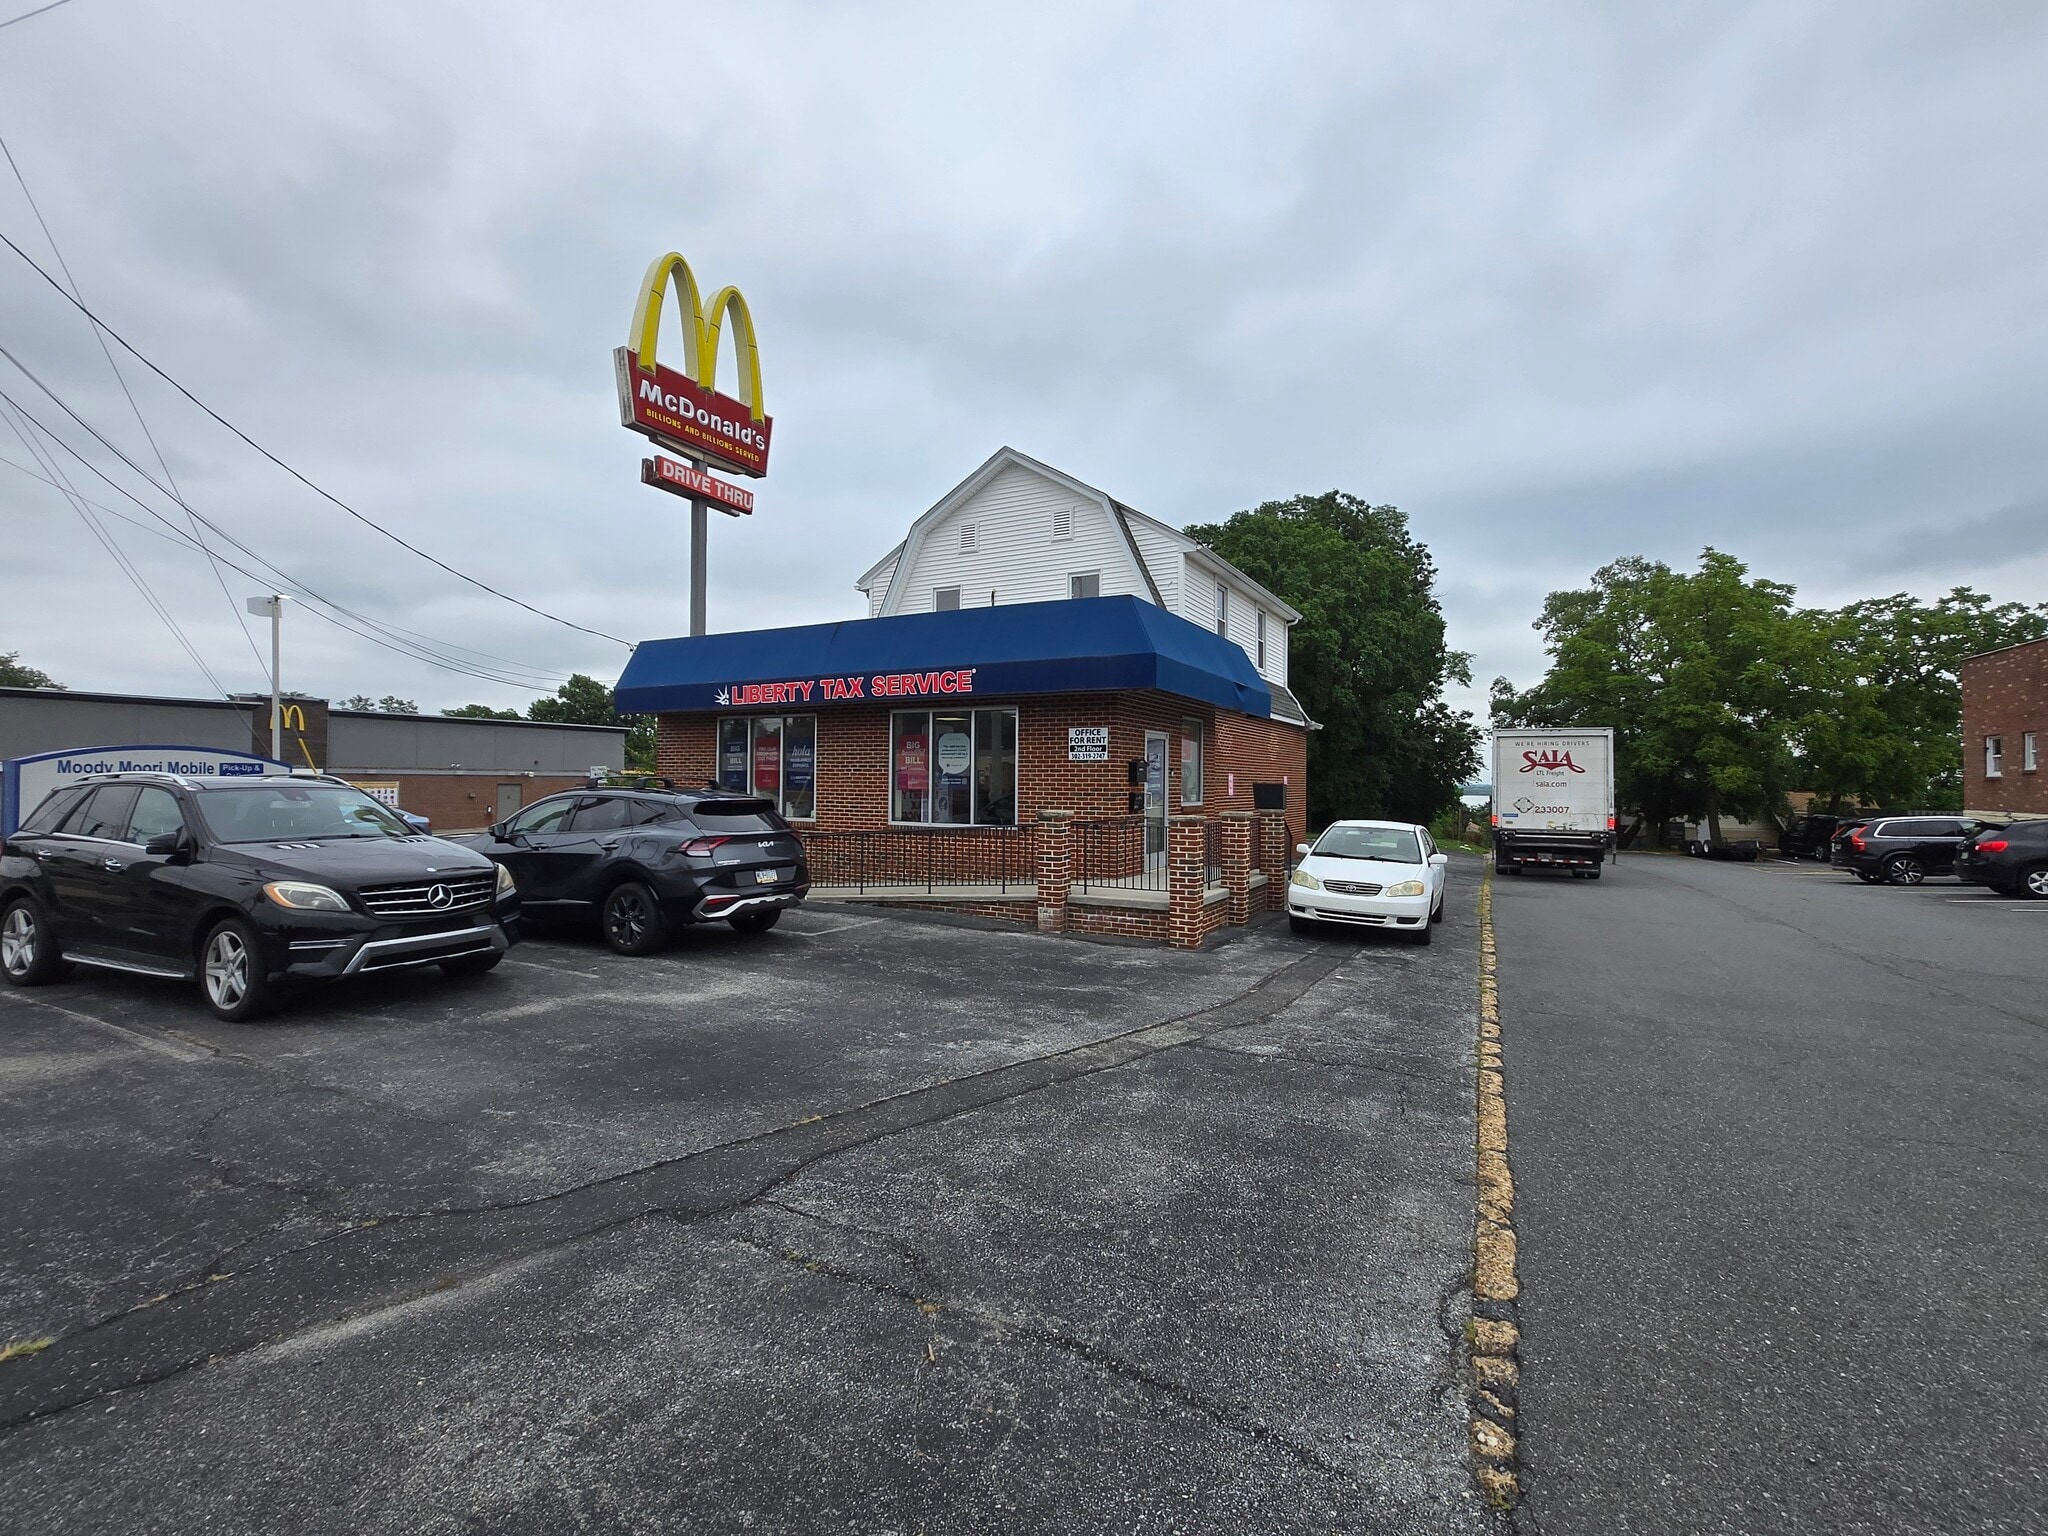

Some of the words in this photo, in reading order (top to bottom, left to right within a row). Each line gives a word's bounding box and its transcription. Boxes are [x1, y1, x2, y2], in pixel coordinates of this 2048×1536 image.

[639, 379, 766, 451] McDonald's
[646, 408, 682, 430] BILLIONS
[684, 424, 700, 437] AND
[702, 432, 733, 452] BILLIONS
[735, 446, 760, 463] SERVED
[662, 460, 712, 493] DRIVE
[715, 481, 753, 509] THRU
[731, 680, 815, 705] LIBERTY
[819, 676, 864, 699] TAX
[871, 669, 973, 697] SERVICE
[1074, 728, 1102, 736] OFFICE
[906, 741, 921, 749] BIG
[1086, 736, 1106, 744] RENT
[792, 745, 811, 756] hola
[1519, 749, 1586, 774] SAIA
[167, 761, 215, 774] Mobile
[222, 764, 251, 773] Pick-Up
[1535, 780, 1567, 788] saia.com
[1534, 806, 1570, 814] 233007
[757, 840, 774, 848] KIA
